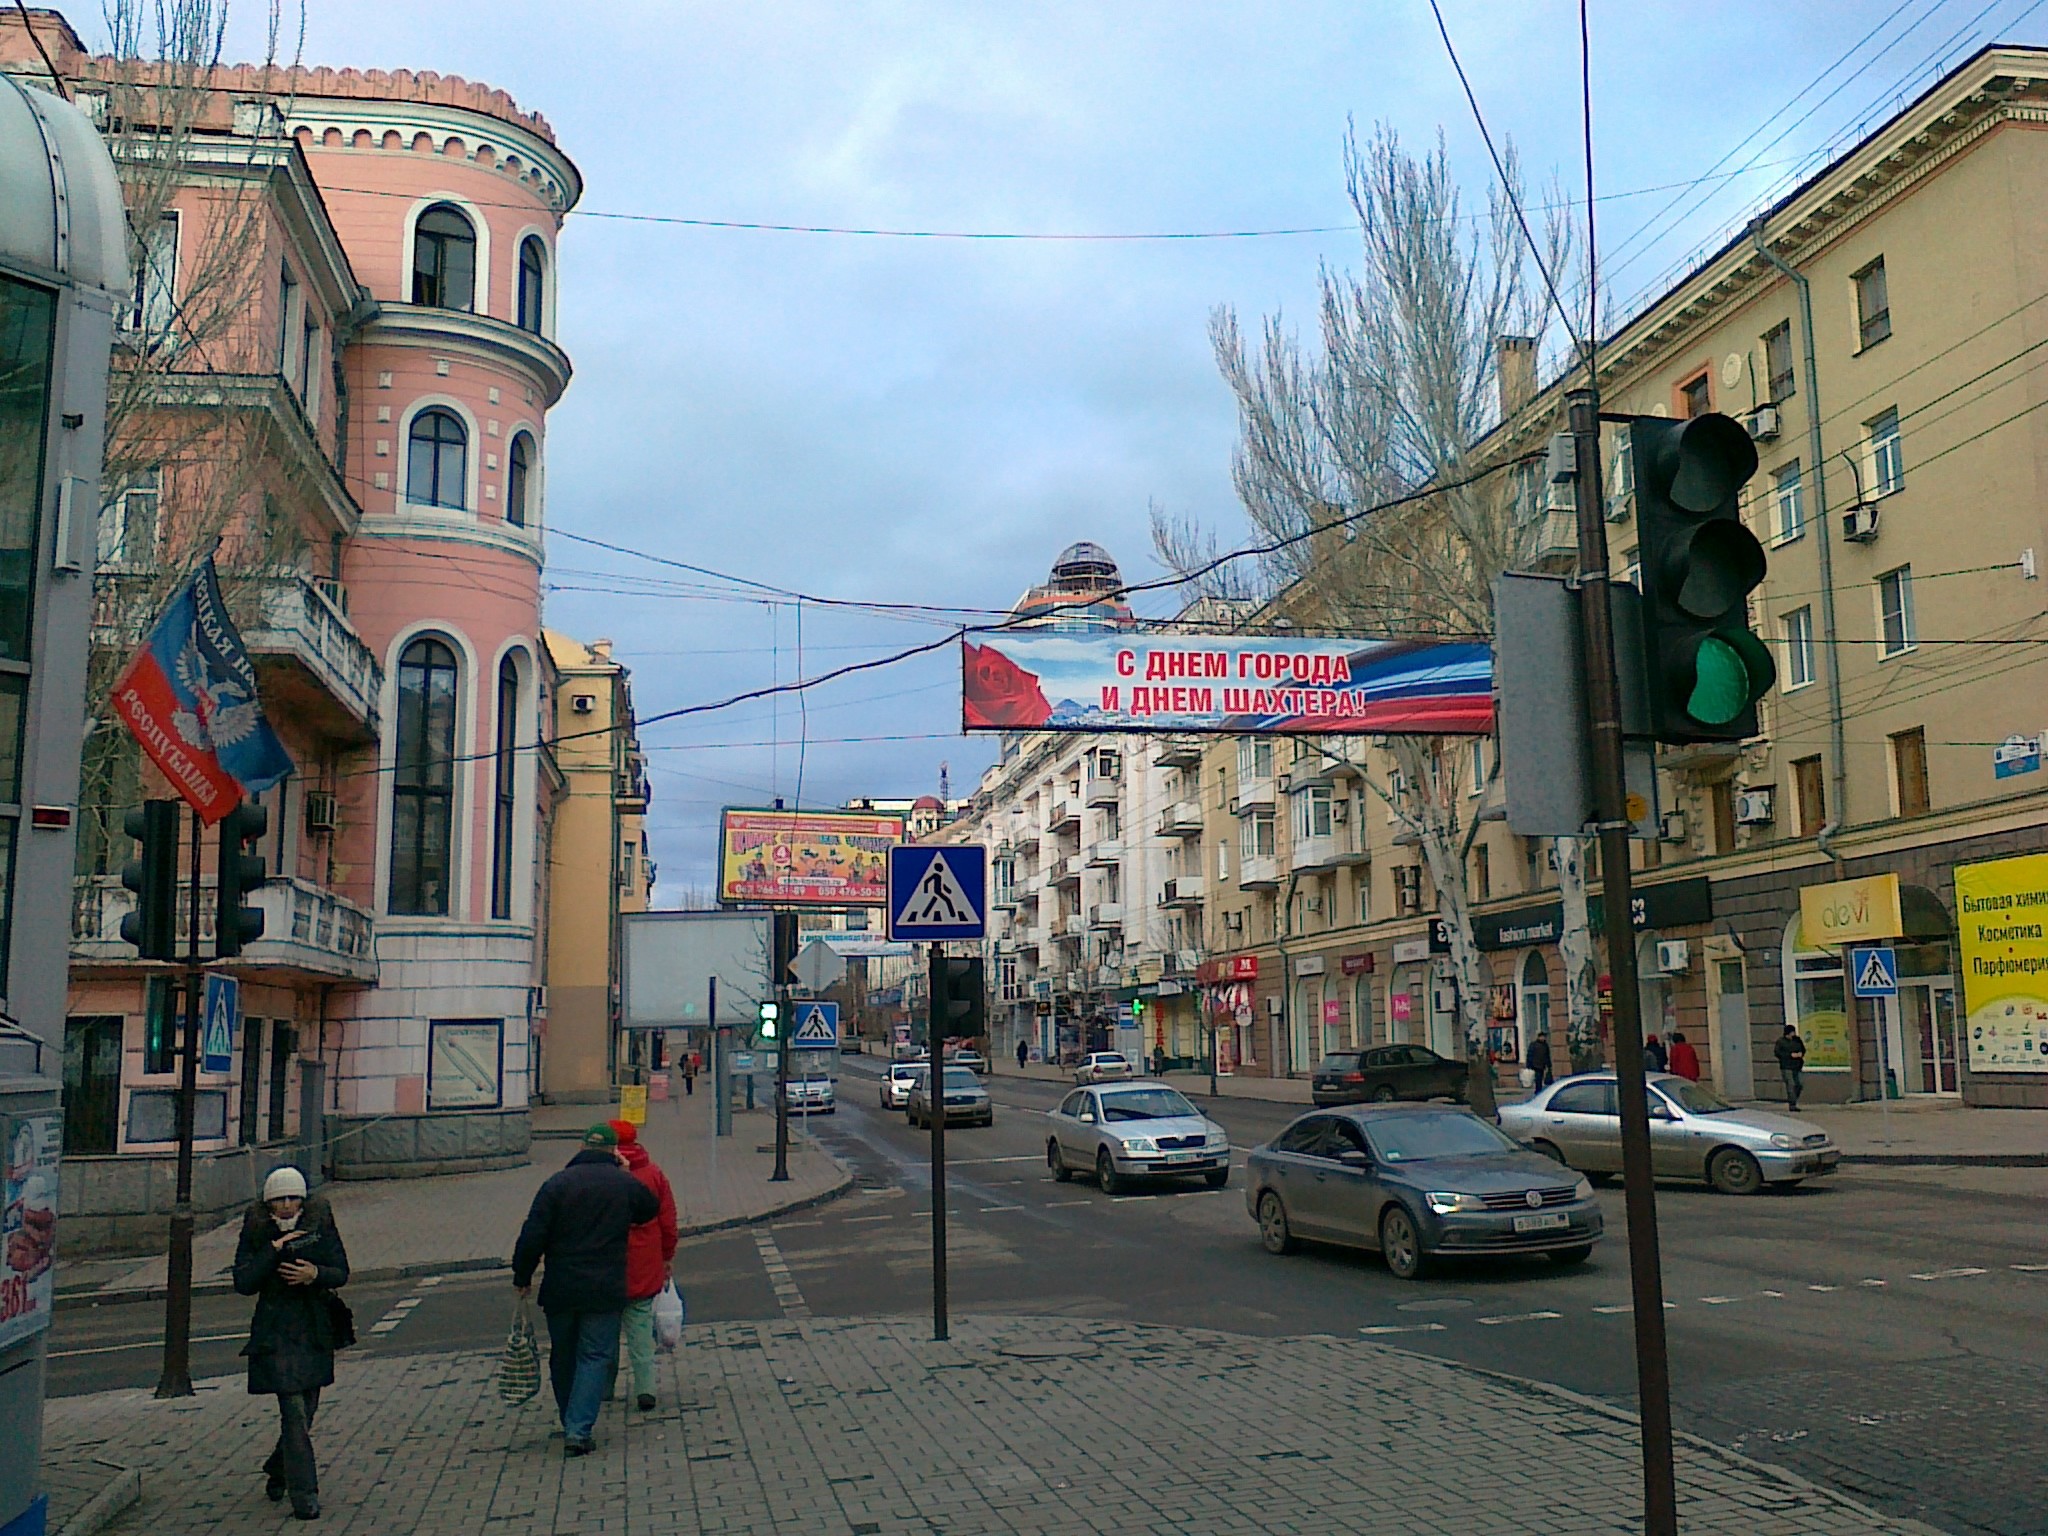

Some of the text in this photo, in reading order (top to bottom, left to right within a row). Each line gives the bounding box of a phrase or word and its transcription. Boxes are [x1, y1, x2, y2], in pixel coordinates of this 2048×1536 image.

[1118, 650, 1349, 685] С ДНЕМ ГОРОДА
[1102, 686, 1366, 717] И ДНЕМ ШАХТЕРА!
[1963, 894, 2013, 913] Бытовая
[1499, 920, 1553, 943] fashion market
[1978, 924, 2043, 943] Косметика
